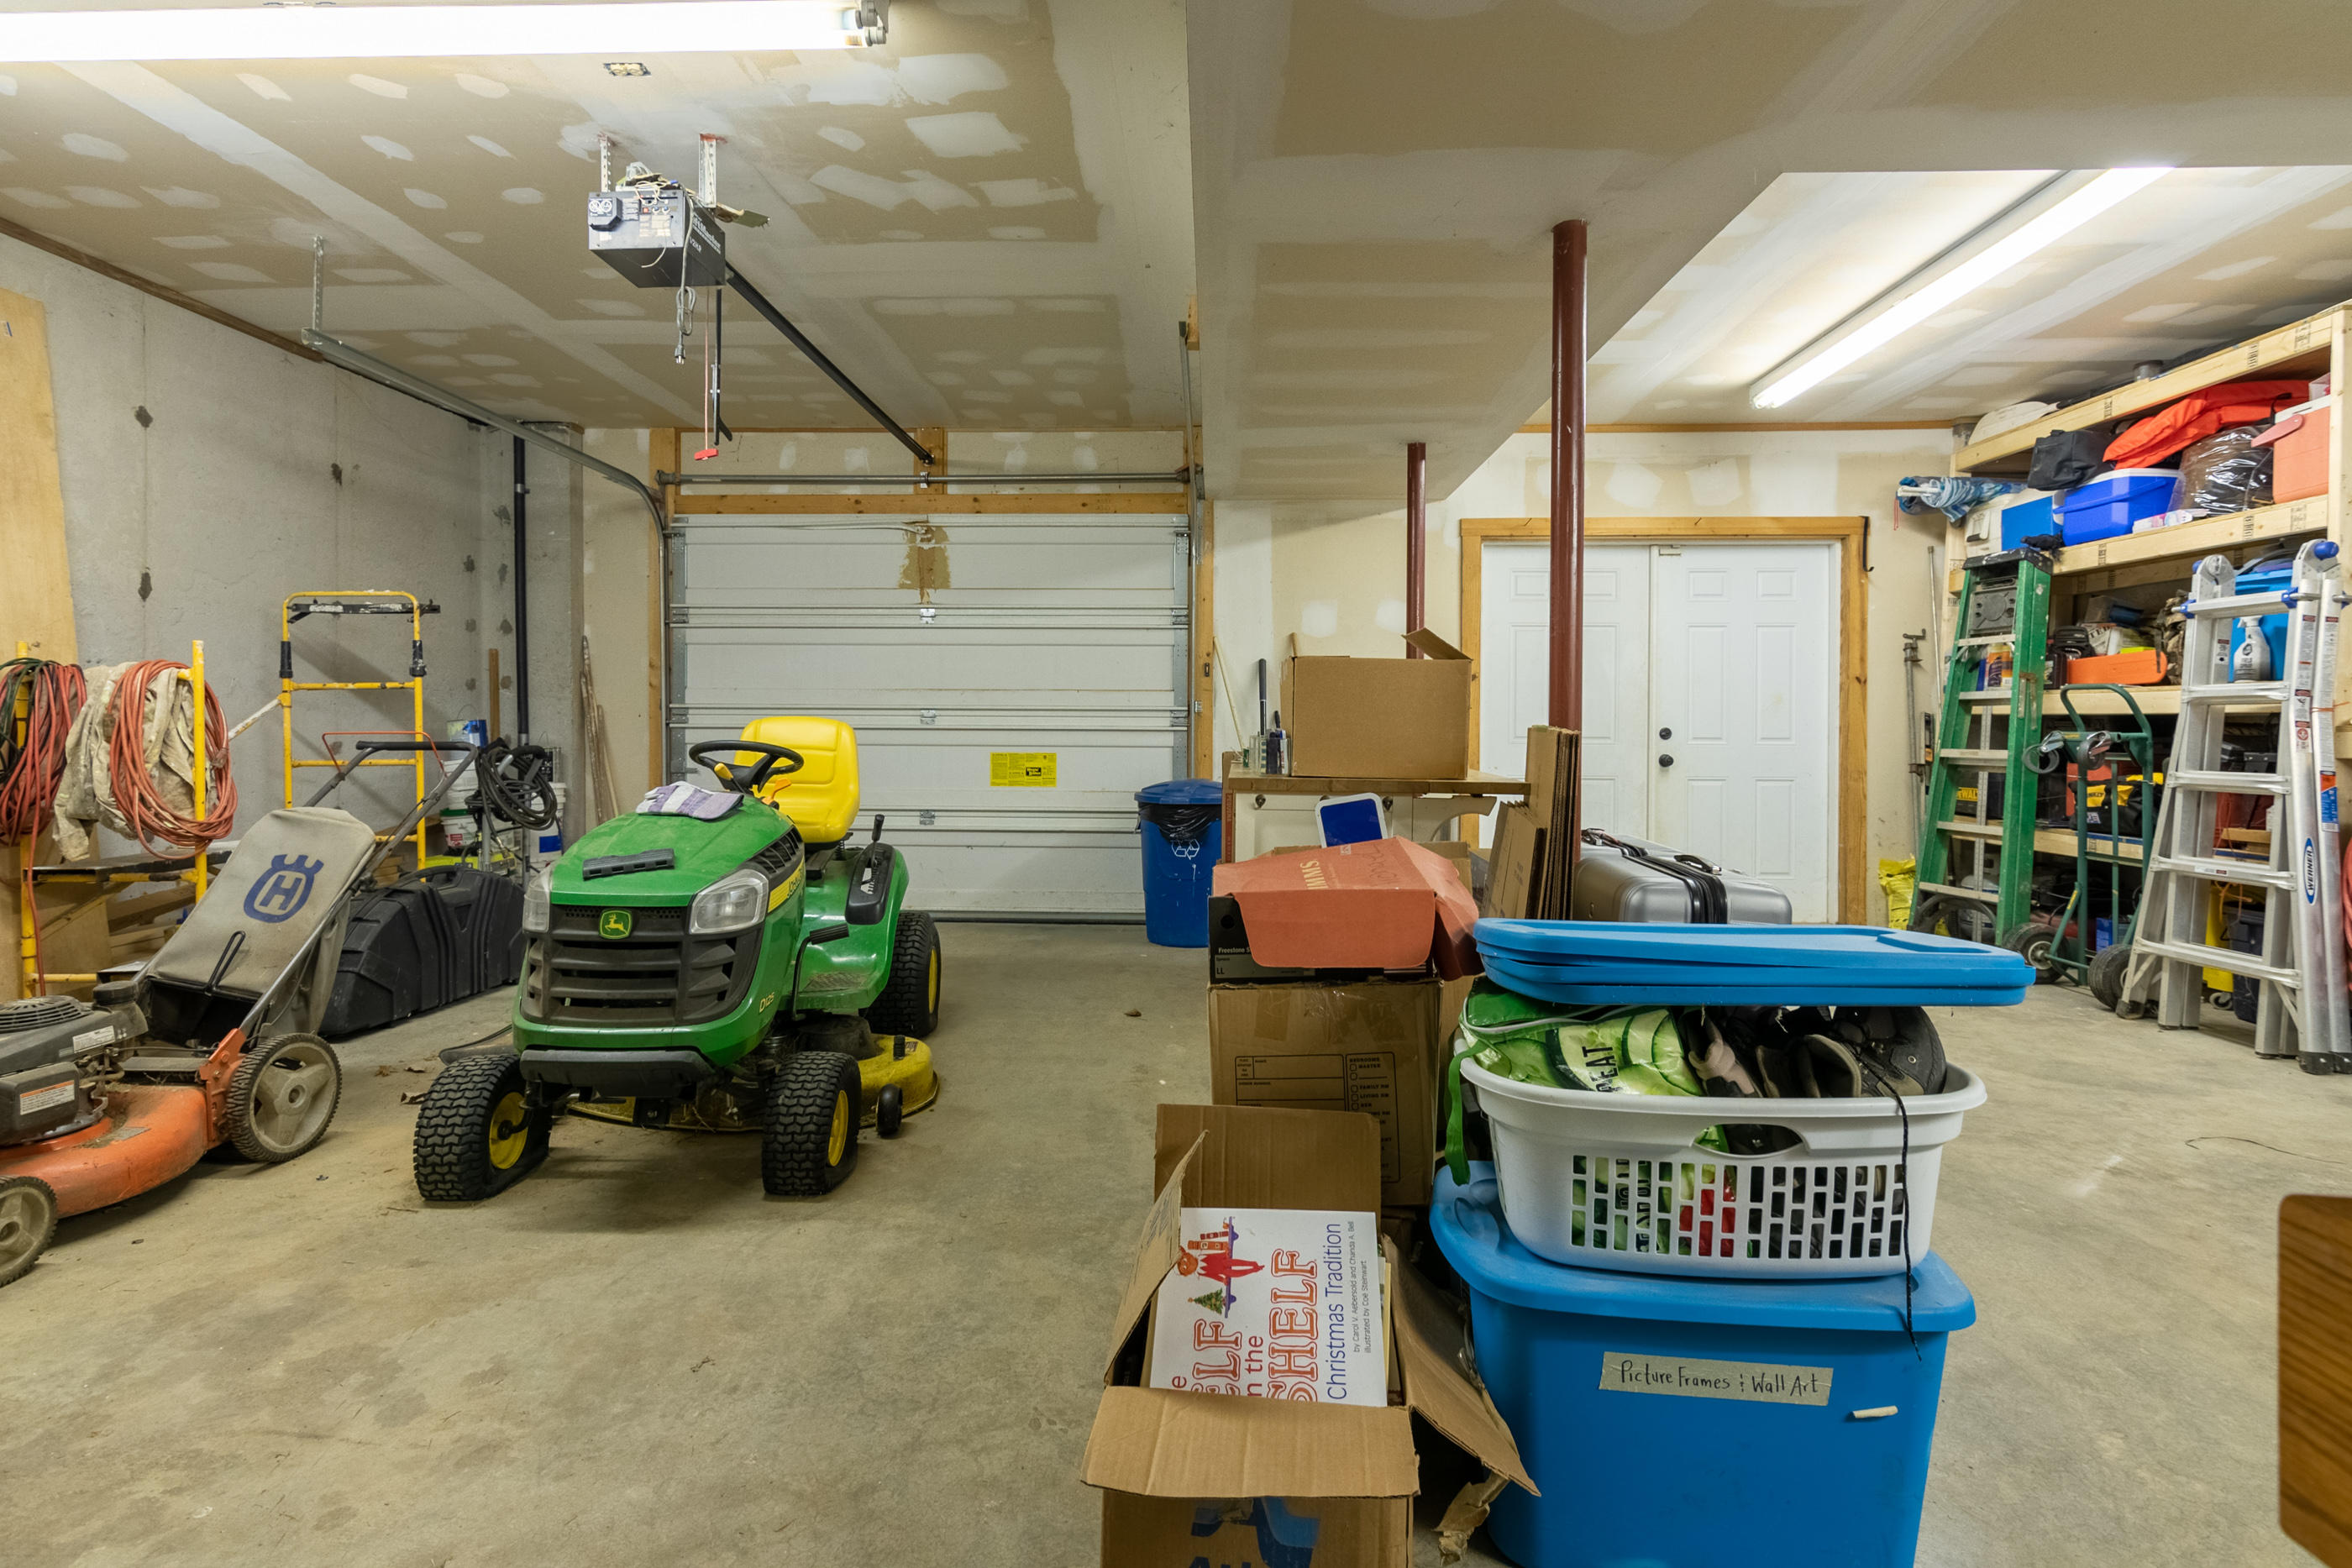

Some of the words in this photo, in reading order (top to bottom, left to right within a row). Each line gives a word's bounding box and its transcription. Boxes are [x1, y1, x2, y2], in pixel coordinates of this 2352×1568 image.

[1299, 860, 1329, 889] IMMS
[2306, 849, 2314, 891] WERNER
[1323, 1223, 1344, 1298] Tradition
[1350, 1281, 1358, 1314] Aebersold
[1362, 1308, 1370, 1317] by
[1352, 1324, 1360, 1342] Carol
[1352, 1344, 1361, 1353] by
[1244, 1335, 1263, 1374] the
[1325, 1303, 1347, 1400] Christmas
[1247, 1382, 1263, 1397] n
[1620, 1360, 1673, 1385] Picture
[1678, 1366, 1730, 1389] Frames
[1751, 1372, 1785, 1393] Wall
[1789, 1372, 1819, 1397] Art
